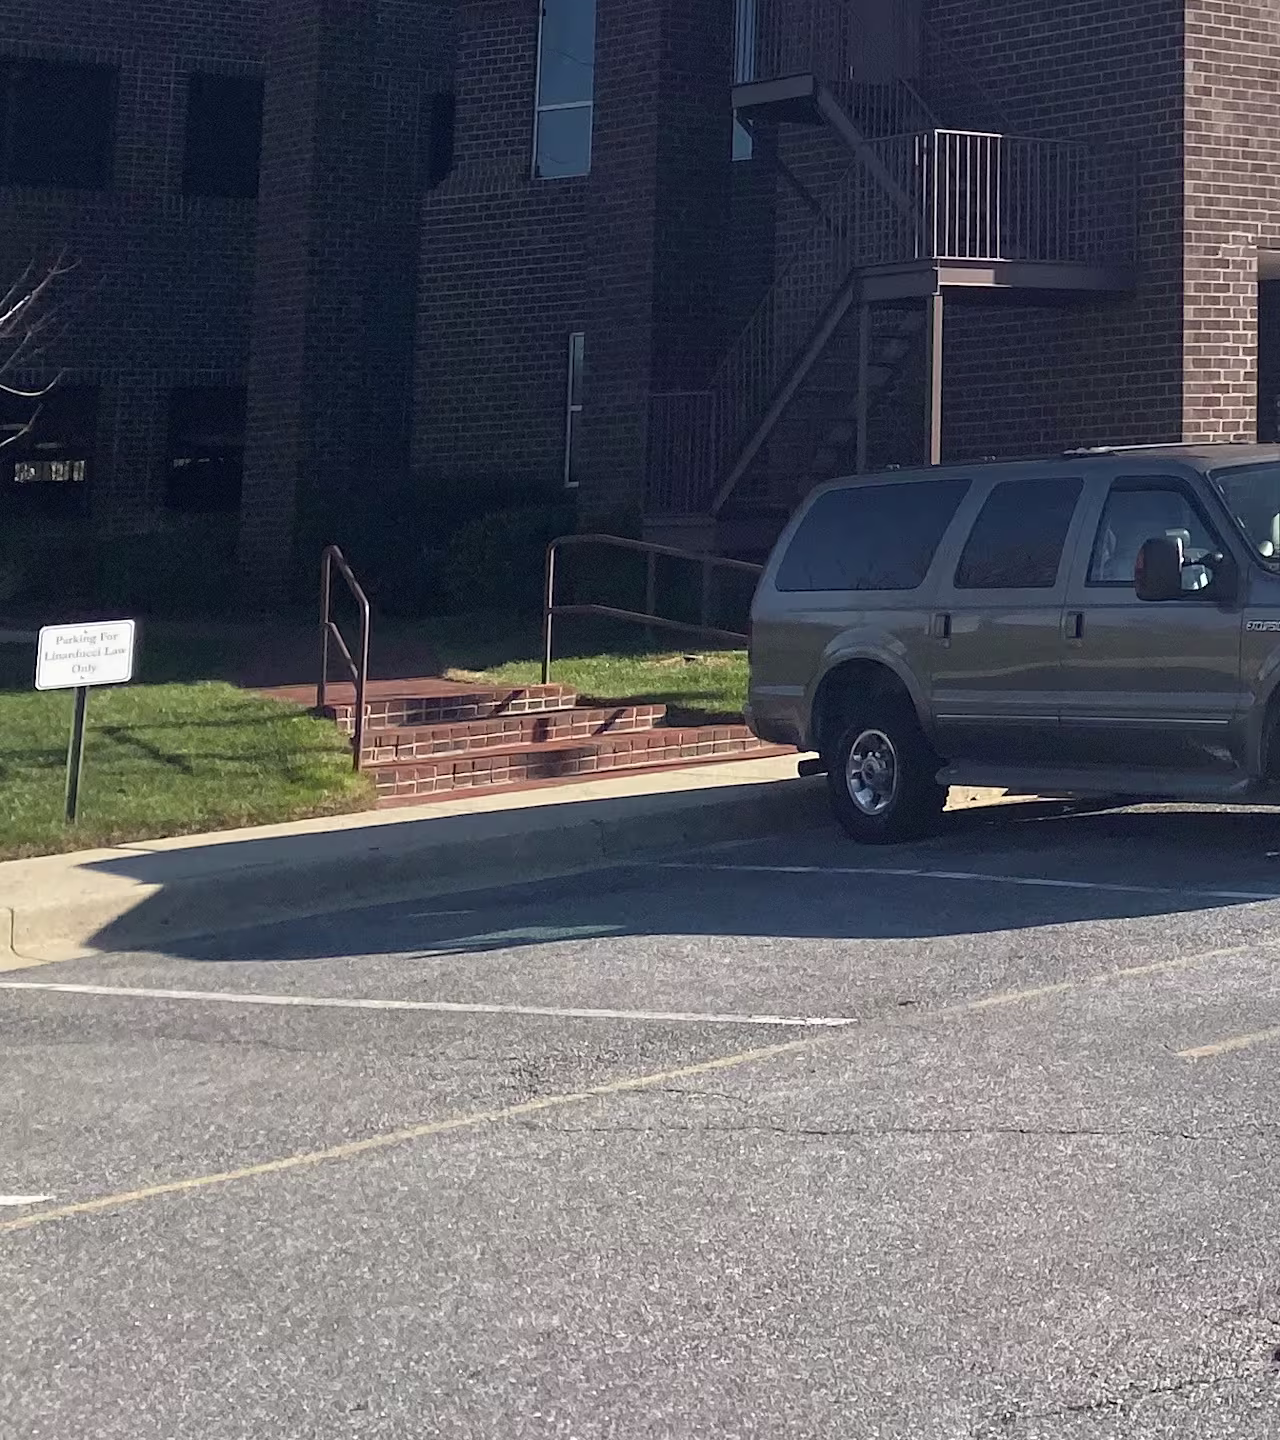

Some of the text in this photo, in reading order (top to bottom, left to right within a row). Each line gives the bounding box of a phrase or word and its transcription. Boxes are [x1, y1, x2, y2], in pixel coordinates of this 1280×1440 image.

[56, 632, 119, 645] Parking For
[105, 646, 127, 656] Law
[71, 664, 97, 674] Only
